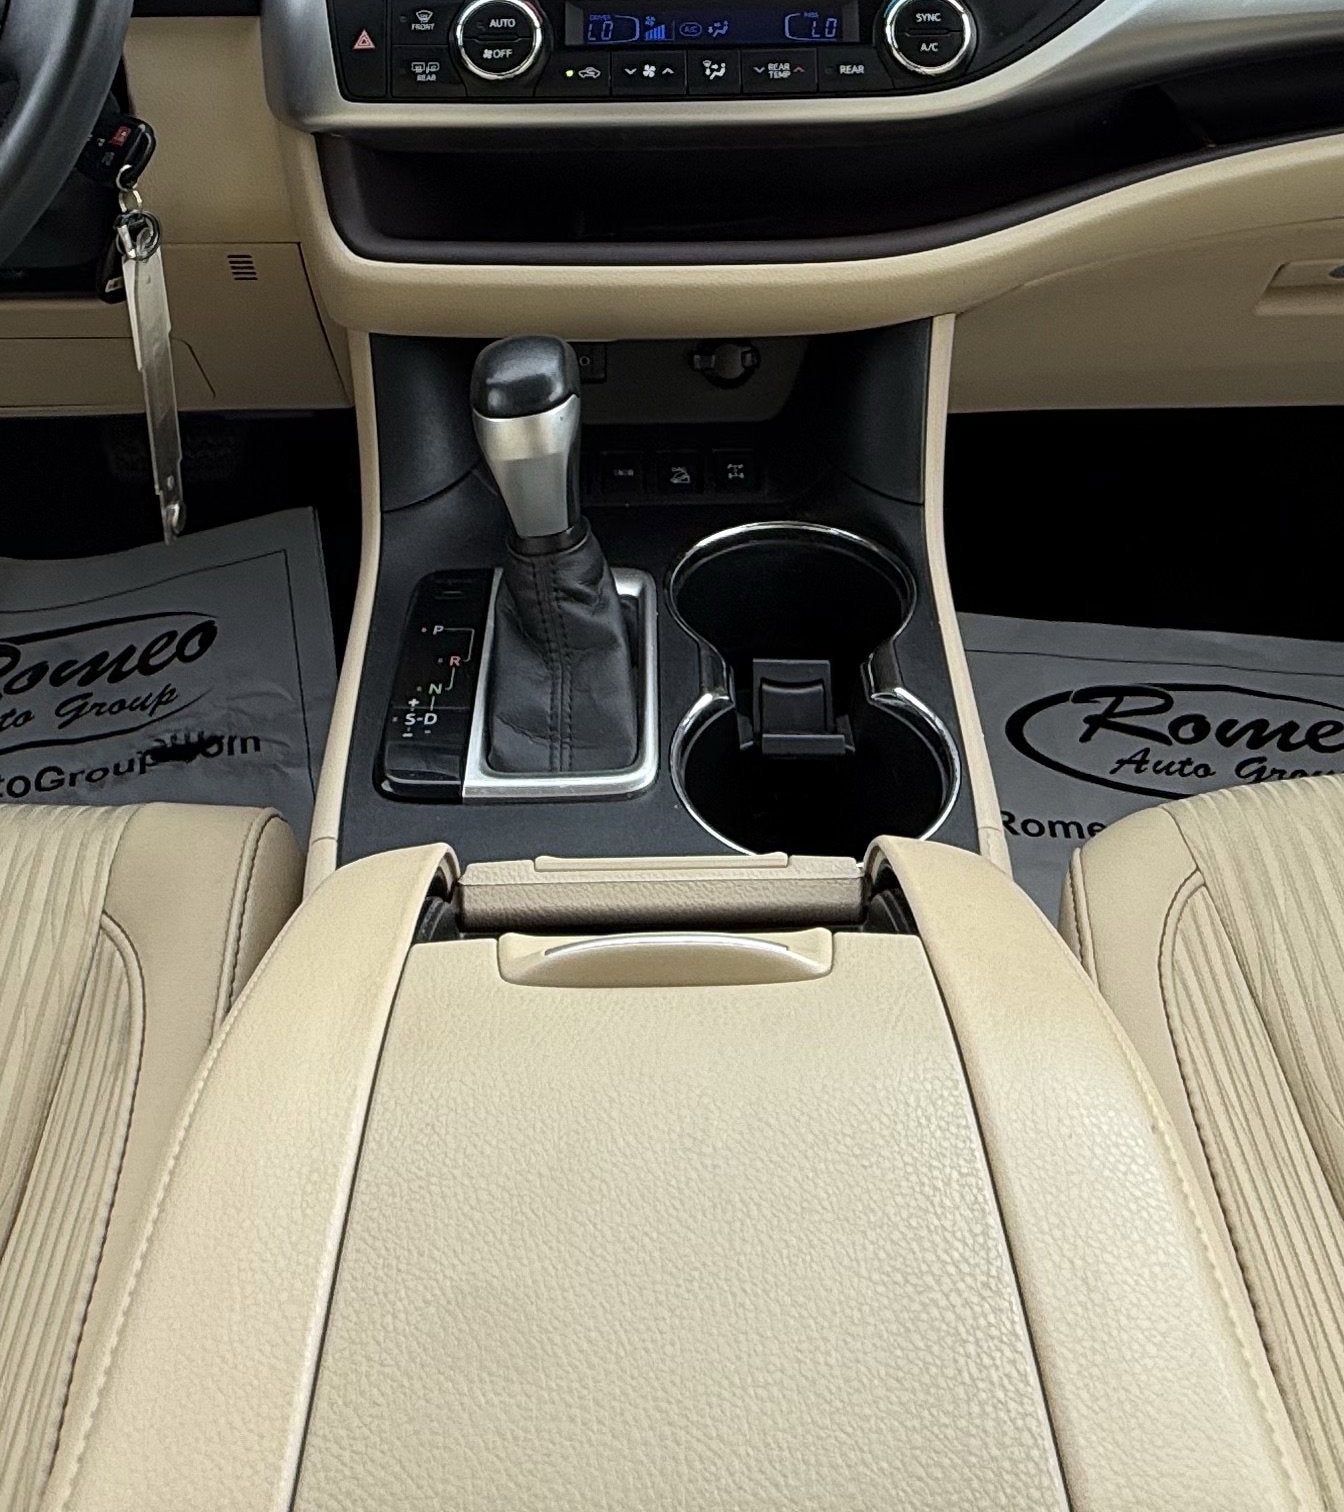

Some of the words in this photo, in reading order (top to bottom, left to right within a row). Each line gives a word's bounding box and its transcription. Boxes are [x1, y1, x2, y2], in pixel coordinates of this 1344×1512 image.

[915, 12, 941, 22] SYNC
[411, 23, 435, 31] FRONT
[489, 18, 516, 28] AUTO
[920, 42, 940, 52] A/C
[492, 49, 513, 59] OFF
[768, 62, 790, 71] REAR
[839, 65, 864, 74] REAR
[769, 70, 791, 79] TEMP
[432, 625, 444, 635] P
[449, 656, 461, 667] R
[428, 683, 442, 695] N
[55, 684, 178, 730] Group
[1110, 747, 1216, 778] Auto
